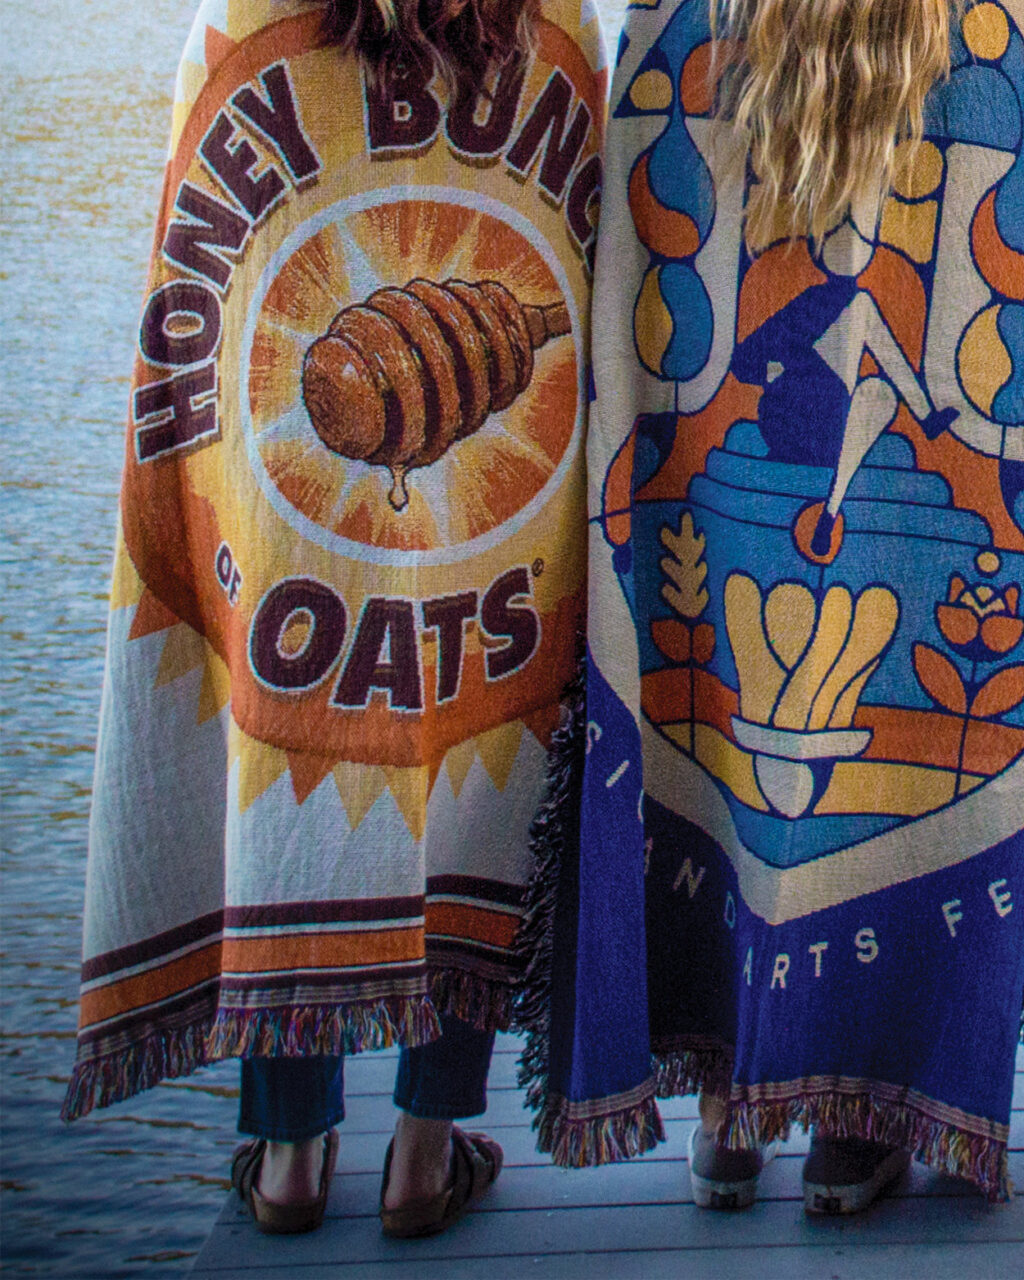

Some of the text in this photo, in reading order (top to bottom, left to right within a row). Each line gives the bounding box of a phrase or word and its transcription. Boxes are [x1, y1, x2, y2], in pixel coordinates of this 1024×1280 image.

[132, 58, 323, 463] HONEY
[215, 540, 244, 607] OF
[742, 927, 879, 991] ARTS
